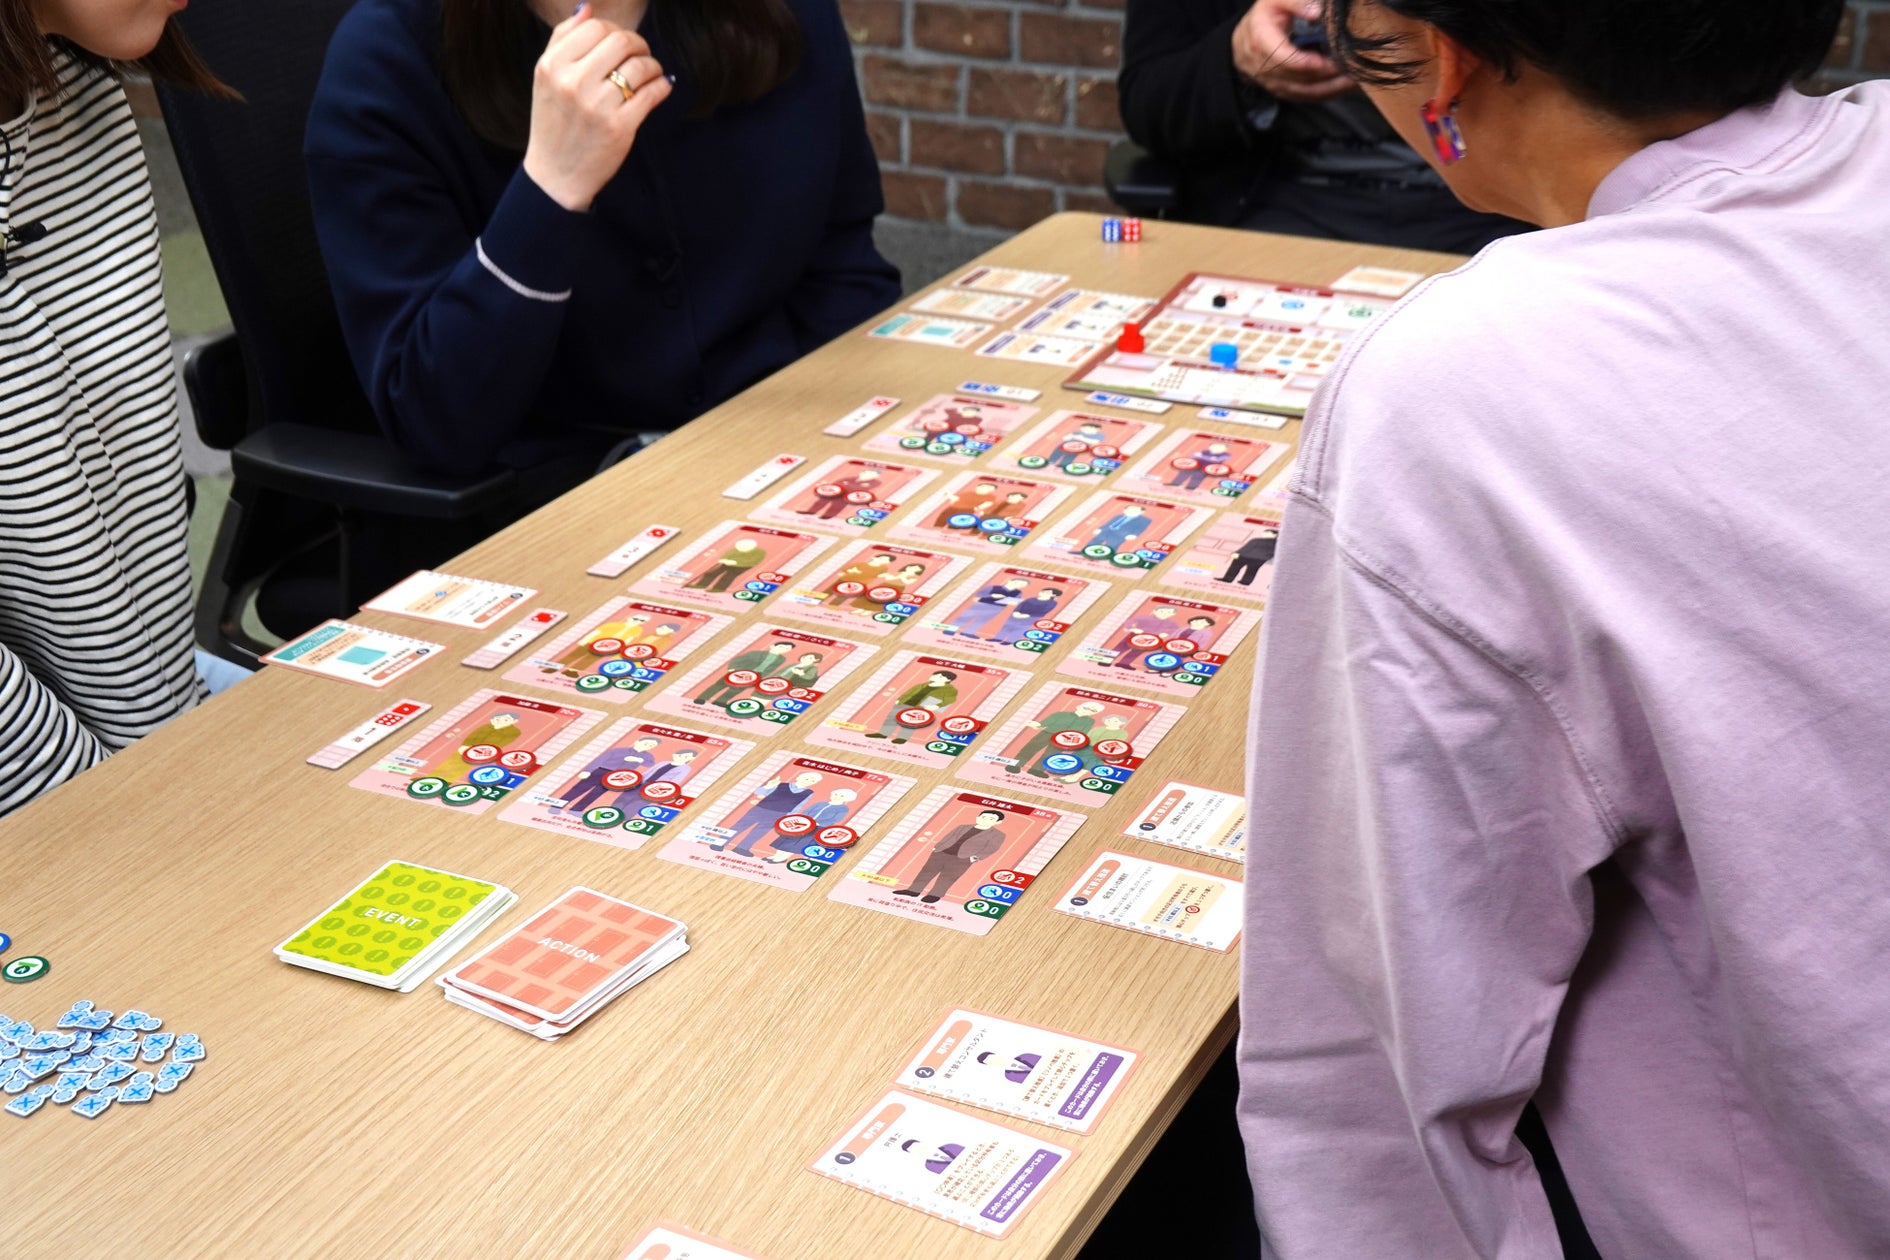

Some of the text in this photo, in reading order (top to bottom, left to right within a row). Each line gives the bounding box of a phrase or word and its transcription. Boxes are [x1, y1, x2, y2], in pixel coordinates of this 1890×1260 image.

[1103, 783, 1111, 791] 0
[675, 798, 684, 806] 0
[826, 850, 834, 859] 0
[810, 864, 820, 873] 0
[1014, 876, 1024, 885] 2
[1002, 891, 1012, 900] 0
[990, 906, 999, 915] 0
[364, 907, 422, 928] EVENT
[538, 937, 601, 963] ACTION
